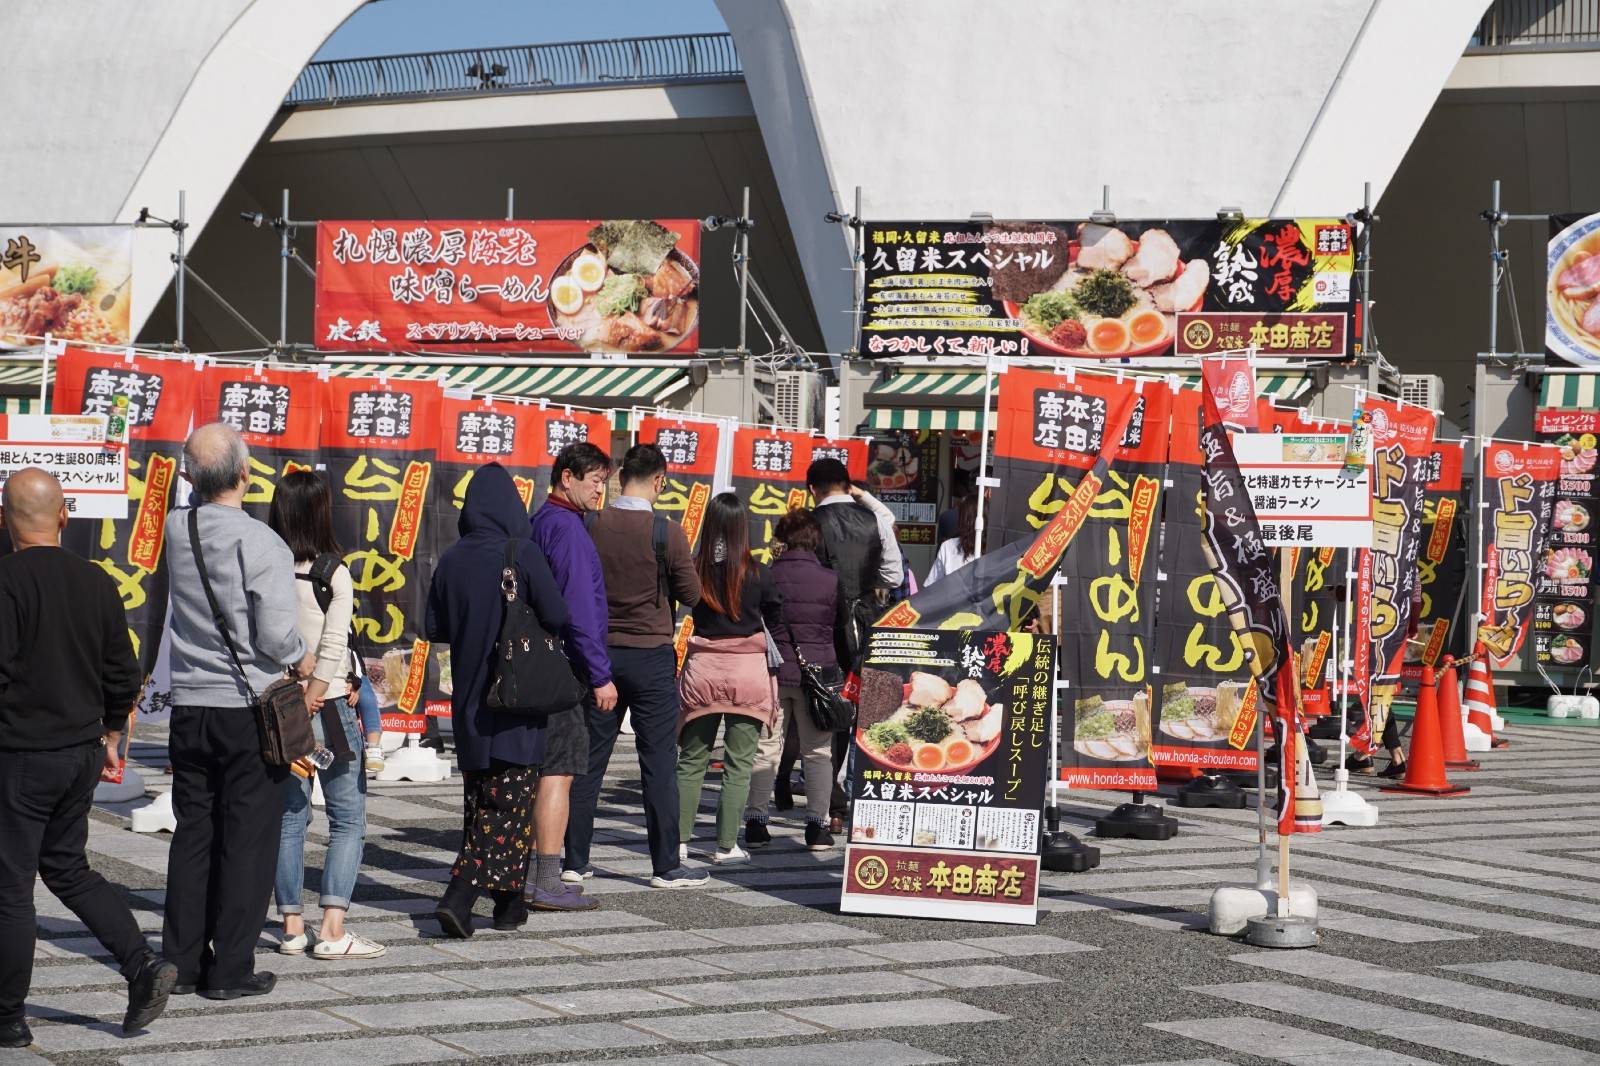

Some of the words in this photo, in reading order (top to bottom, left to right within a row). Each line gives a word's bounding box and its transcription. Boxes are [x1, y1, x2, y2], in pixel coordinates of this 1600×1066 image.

[333, 229, 537, 265] 札幌濃厚海老
[872, 231, 941, 244] 福岡・久留米
[943, 232, 1057, 244] 元祖とんこつ生誕80周年
[0, 235, 41, 282] 牛
[872, 247, 1054, 272] 久留米スペシャル
[1212, 241, 1258, 303] 熟成
[1260, 224, 1310, 300] 濃厚
[390, 269, 549, 302] 味噌らーめん
[327, 317, 387, 342] 虎鉄
[1216, 336, 1243, 349] 久留米
[1219, 322, 1240, 333] 拉麺
[1249, 321, 1334, 349] 本田商店
[141, 375, 161, 422] 久留米
[272, 386, 289, 431] 久留米
[397, 393, 411, 436] 久留米
[502, 416, 514, 453] 久留米
[579, 423, 588, 443] 久留
[1088, 397, 1105, 450] 久留米
[1129, 397, 1144, 444] 久留米
[687, 431, 698, 463] 久留米
[782, 440, 793, 470] 久留米
[1254, 495, 1320, 510] 醤油ラーメン
[1260, 524, 1314, 541] 最後尾
[961, 645, 985, 679] 熟成
[984, 635, 1011, 673] 濃厚
[1031, 639, 1051, 749] 伝統の継ぎ足し
[1004, 675, 1030, 801] 「呼び戻しスープ」
[1152, 750, 1257, 766] www.honda-shouten.com
[863, 770, 912, 782] 福岡・久留米
[862, 783, 994, 805] 久留米スペシャル
[890, 875, 922, 893] 久留米
[929, 861, 1026, 898] 本田商店
